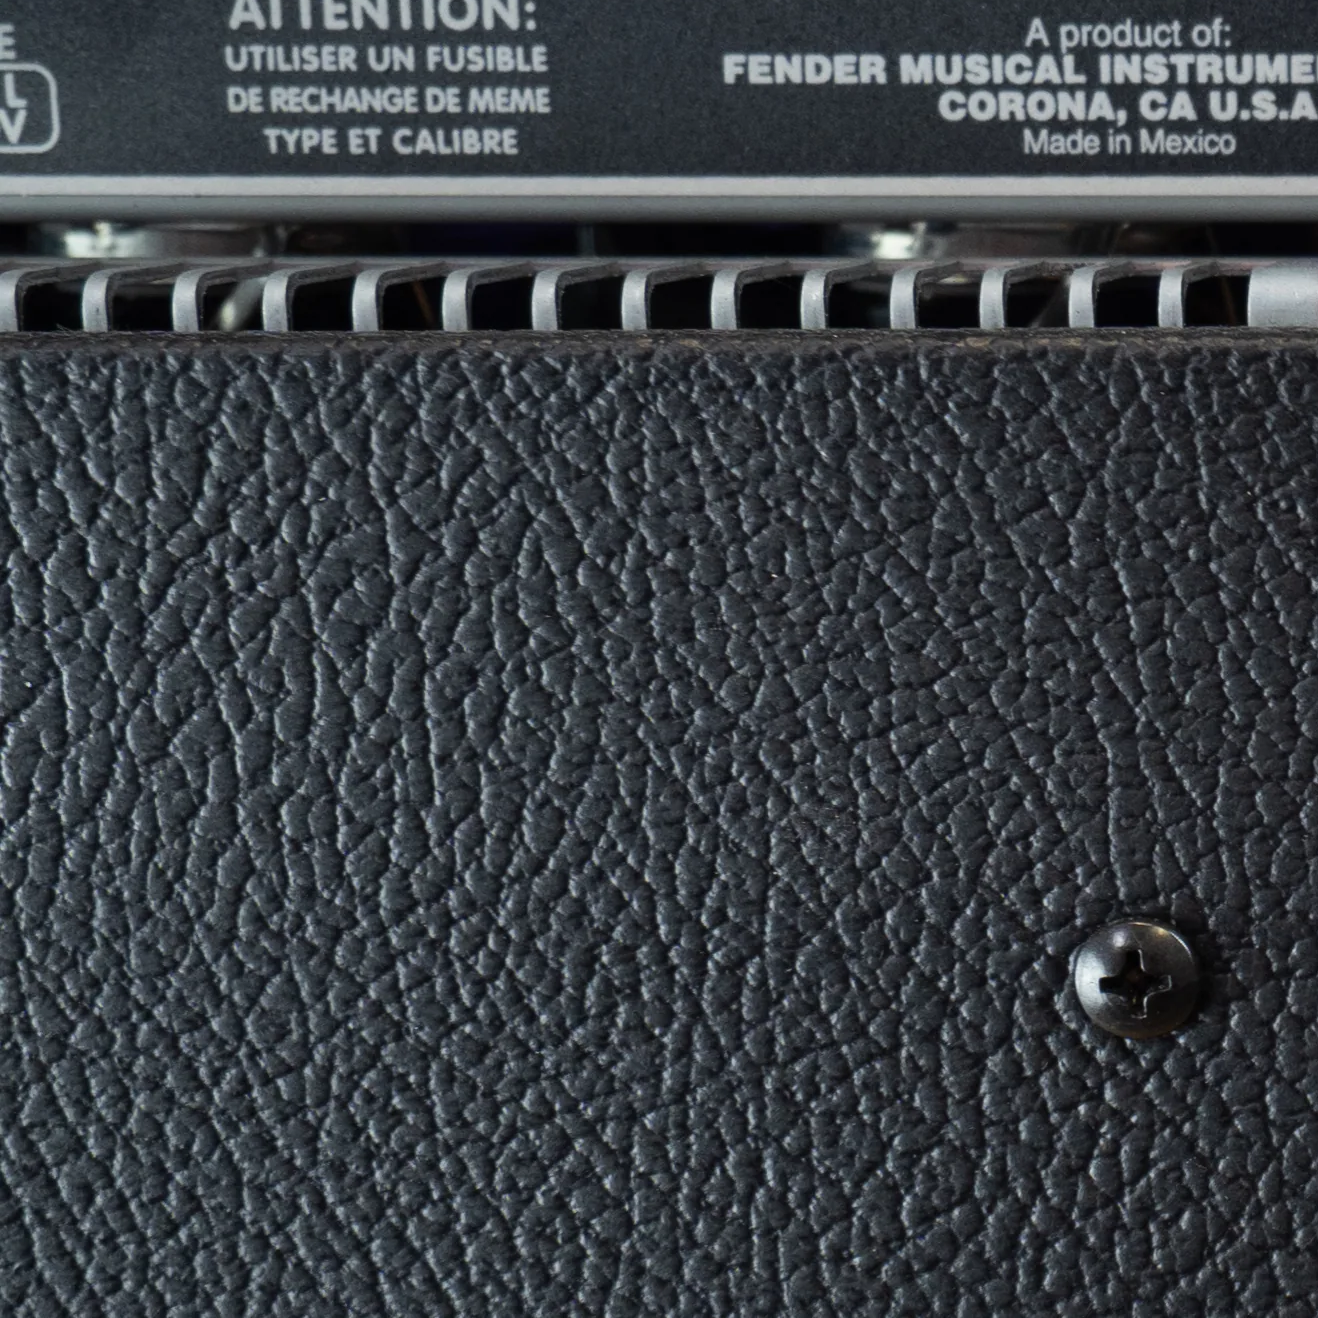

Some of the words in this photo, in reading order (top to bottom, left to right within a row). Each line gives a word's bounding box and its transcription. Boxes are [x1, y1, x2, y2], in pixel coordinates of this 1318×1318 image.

[1024, 16, 1051, 48] A
[1058, 17, 1183, 53] product
[1190, 16, 1232, 48] of:
[224, 43, 358, 73] UTILISER
[367, 45, 416, 73] UN
[426, 44, 549, 73] FUSIBLE
[722, 53, 887, 85] FENDER
[898, 51, 1087, 86] MUSICAL
[226, 86, 264, 114] DE
[269, 86, 419, 114] RECHANGE
[424, 86, 462, 114] DE
[467, 86, 551, 114] MEME
[937, 89, 1128, 127] CORONA,
[1138, 89, 1198, 122] CA
[262, 126, 338, 155] TYPE
[347, 126, 382, 155] ET
[392, 127, 519, 155] CALIBRE
[1022, 127, 1101, 156] Made
[1107, 128, 1132, 155] in
[1138, 127, 1237, 156] Mexico
